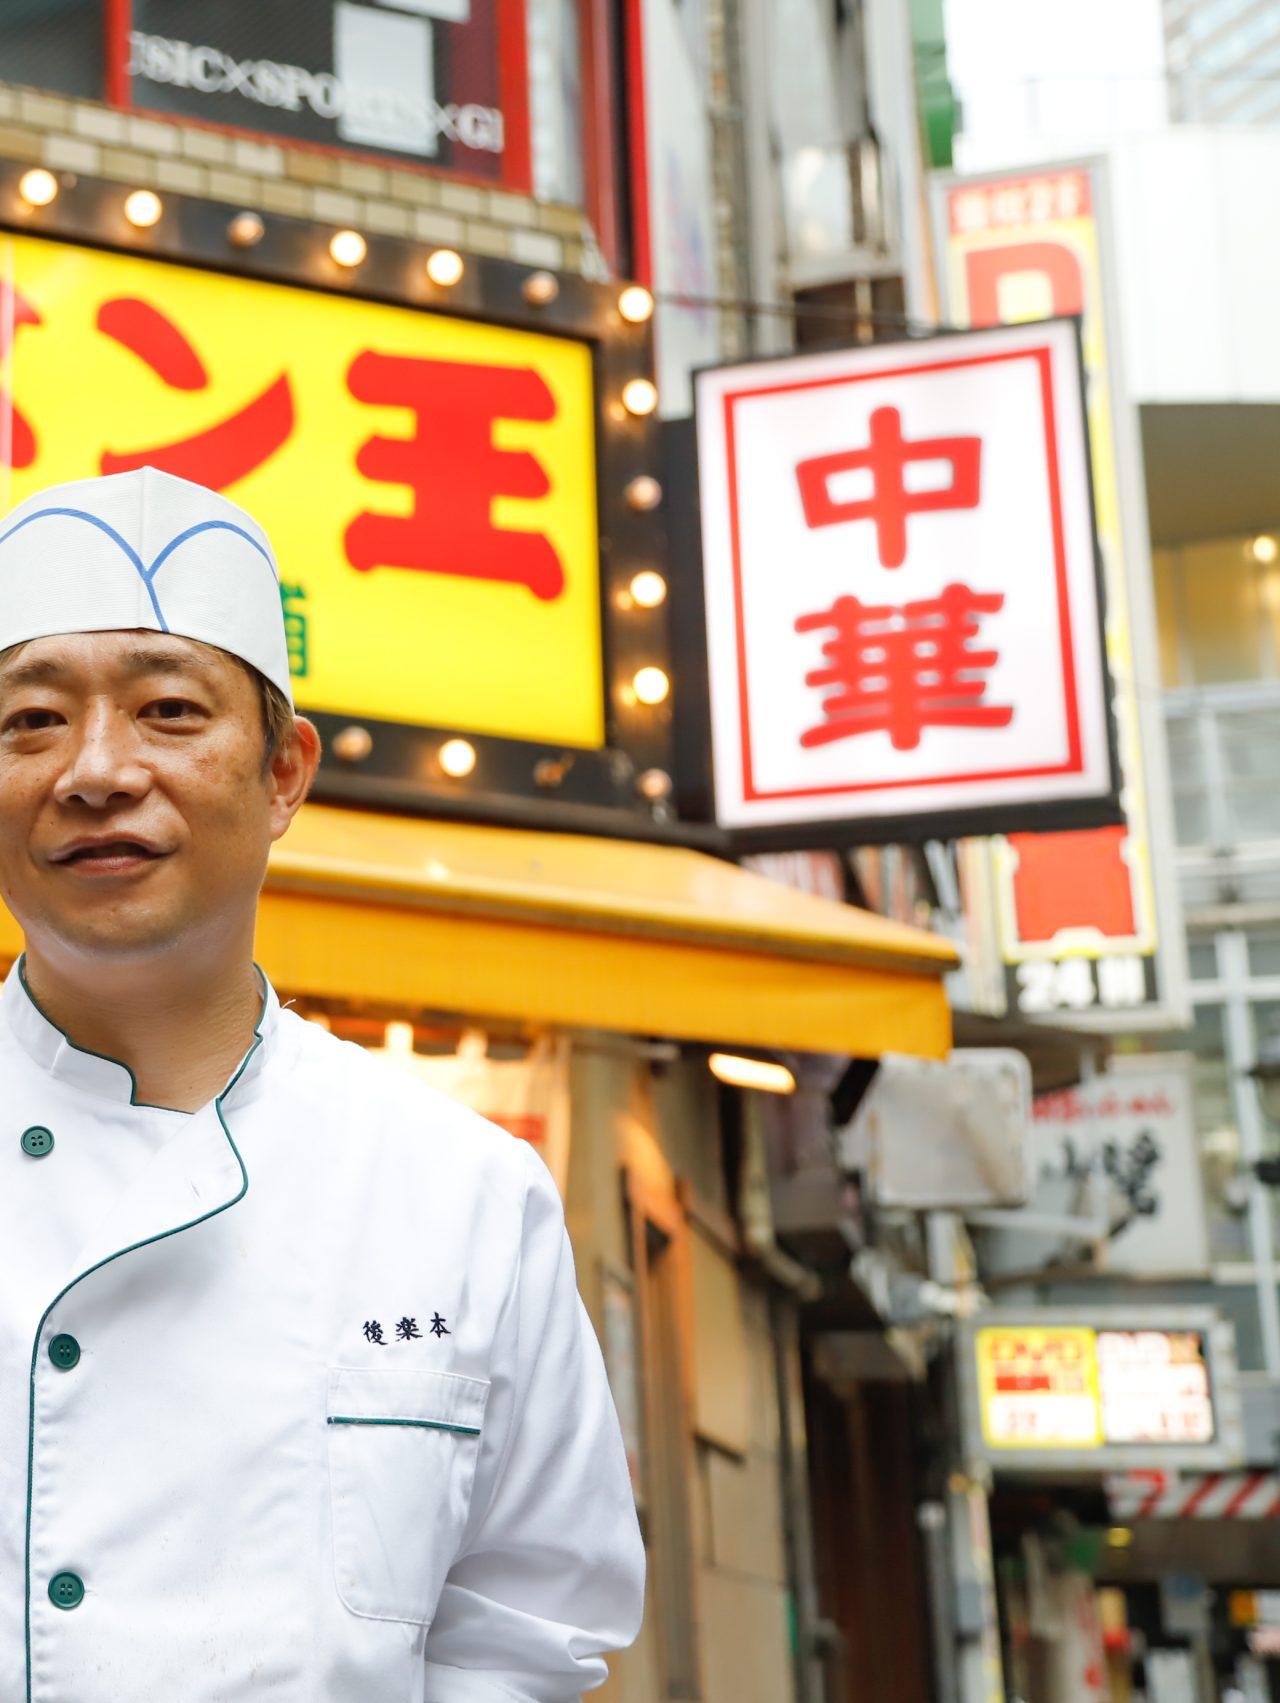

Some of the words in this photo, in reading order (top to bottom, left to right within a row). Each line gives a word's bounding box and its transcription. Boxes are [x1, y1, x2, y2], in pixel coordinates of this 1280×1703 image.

[794, 405, 1014, 752] 中華
[363, 1311, 451, 1345] 後楽本
